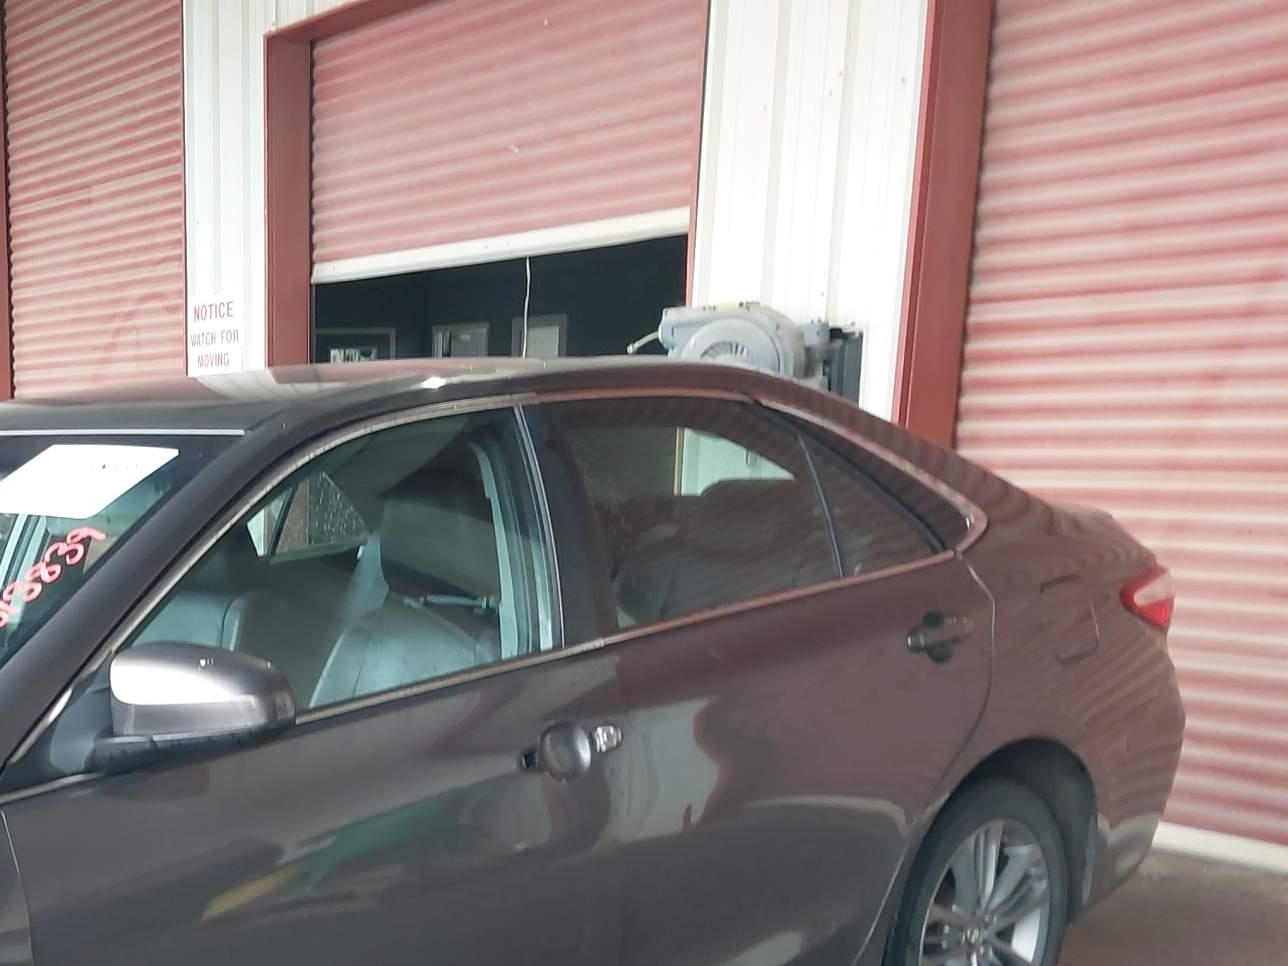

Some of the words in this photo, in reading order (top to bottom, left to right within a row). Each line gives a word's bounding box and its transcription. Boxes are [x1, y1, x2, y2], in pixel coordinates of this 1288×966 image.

[193, 301, 234, 323] NOTICE
[190, 331, 216, 347] WATCH
[220, 328, 239, 344] FOR
[197, 352, 230, 368] MOVING
